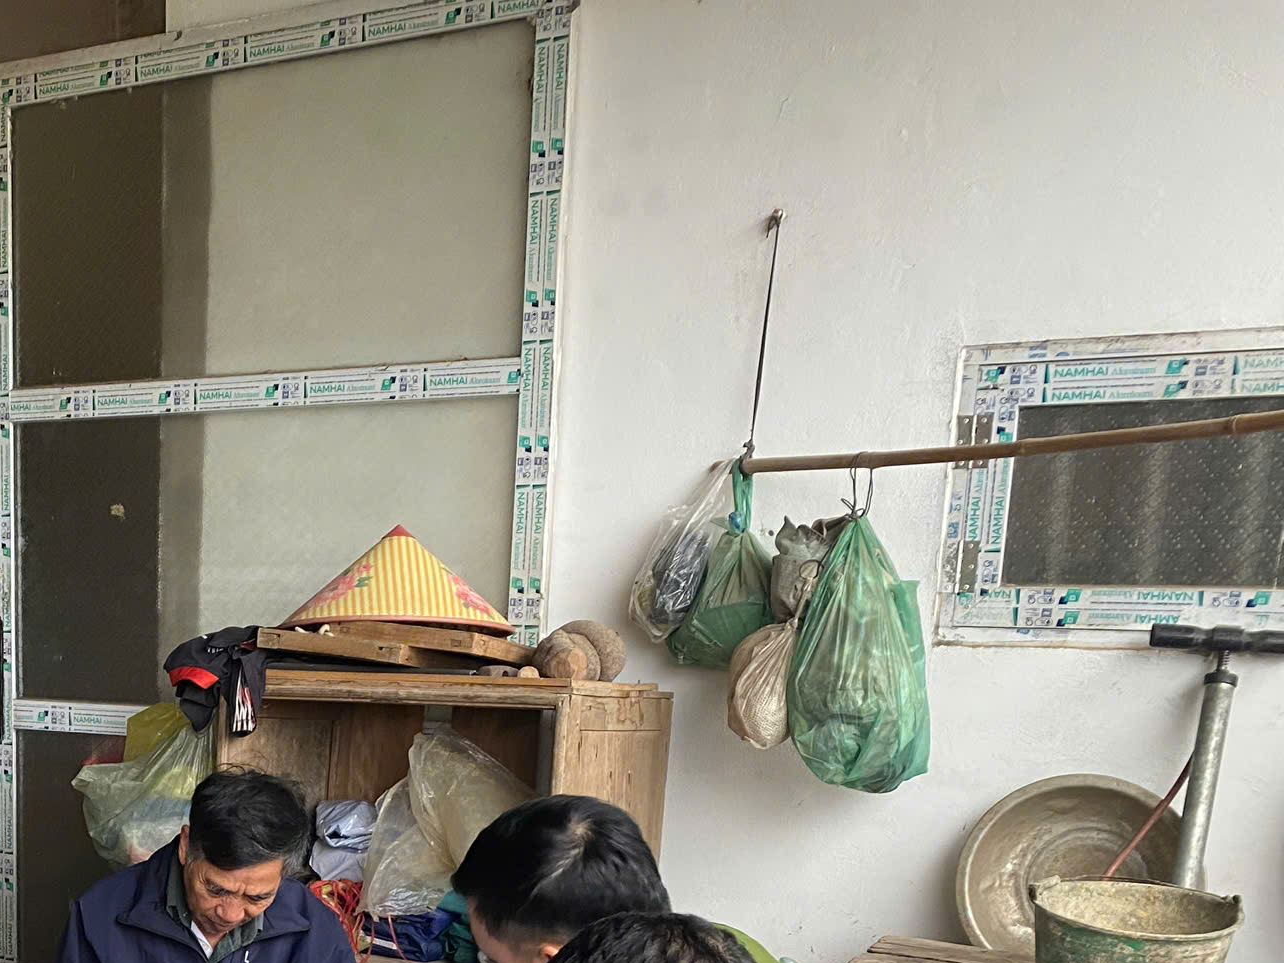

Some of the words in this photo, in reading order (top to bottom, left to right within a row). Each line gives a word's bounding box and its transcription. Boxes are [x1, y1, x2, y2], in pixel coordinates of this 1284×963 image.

[368, 23, 406, 37] NAMHAI
[249, 43, 285, 58] NAMHAI
[140, 65, 173, 78] NAMHAI
[522, 347, 532, 392] NAMHAI
[541, 346, 550, 391] NAMHAI
[1052, 365, 1109, 378] NAMHAI
[429, 375, 468, 387] NAMHAI
[199, 390, 233, 401] NAMHAI
[309, 384, 346, 394] NAMHAI
[1051, 389, 1107, 401] NAMHAI
[97, 396, 129, 407] NAMHAI
[515, 491, 525, 535] NAMHAI
[533, 490, 543, 535] NAMHAI
[990, 496, 1004, 545] NAMHAI
[1137, 591, 1194, 601] NAMHAI
[73, 716, 103, 725] NAMHAI
